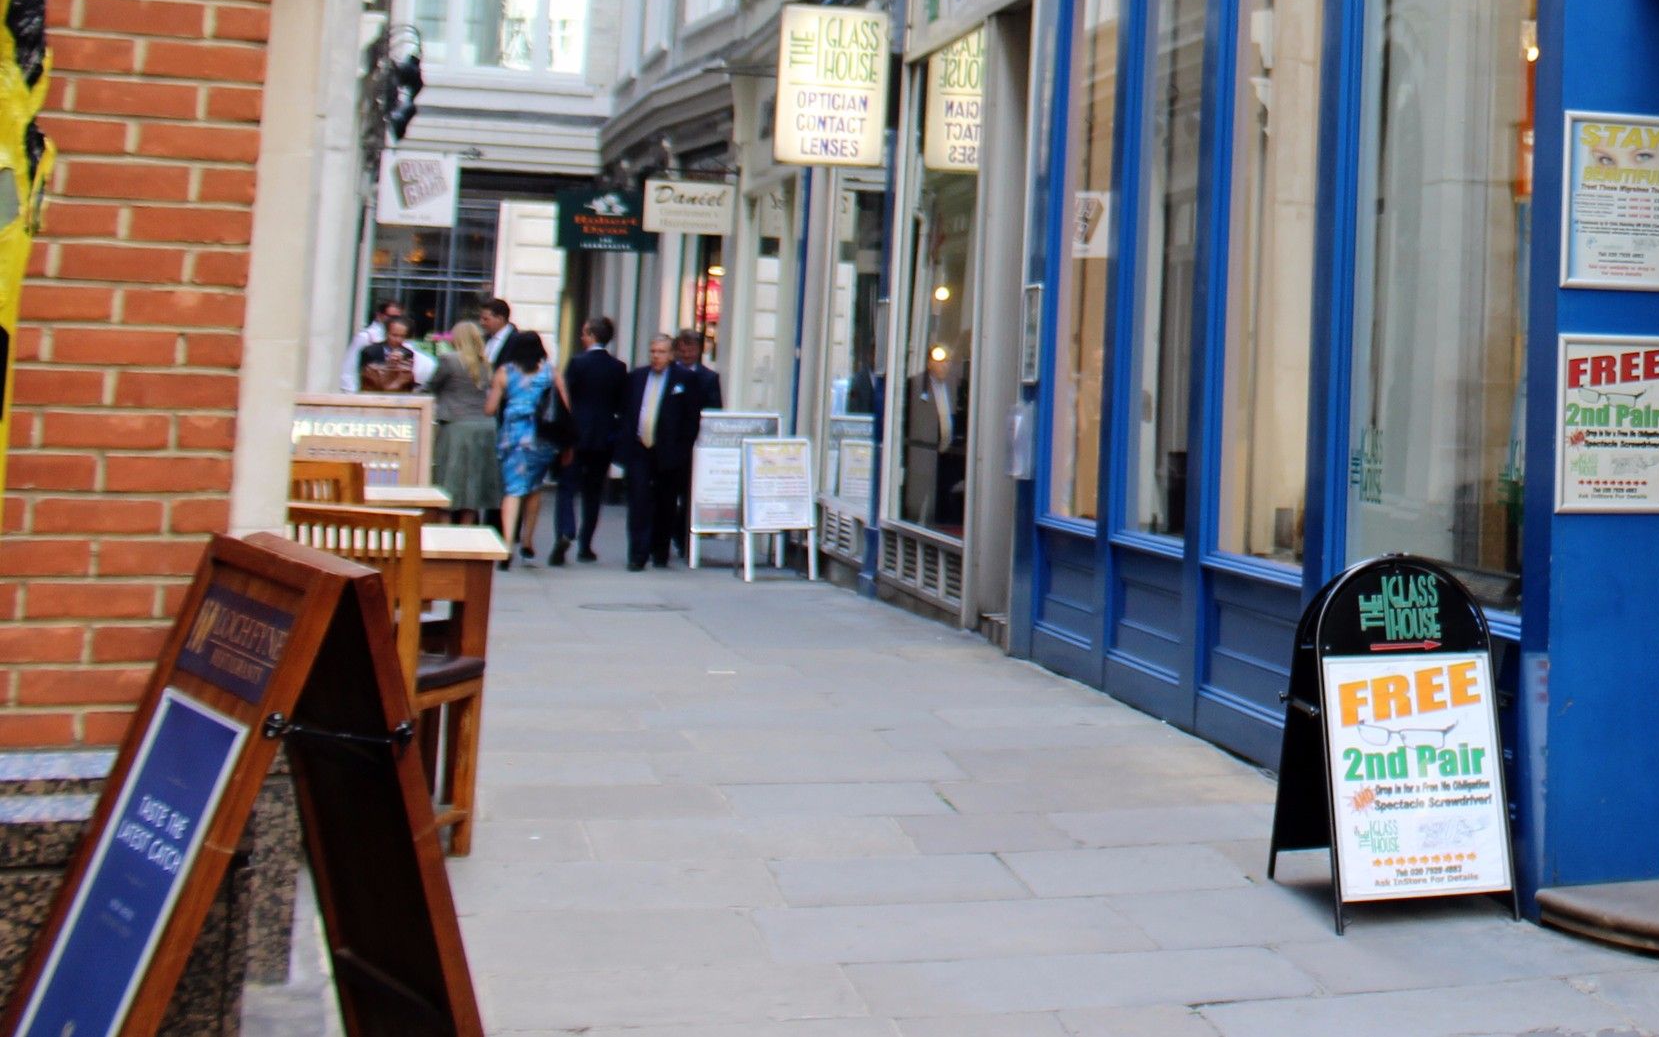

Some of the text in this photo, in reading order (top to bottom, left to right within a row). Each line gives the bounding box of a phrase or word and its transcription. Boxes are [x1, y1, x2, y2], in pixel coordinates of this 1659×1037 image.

[789, 30, 816, 68] THE
[825, 16, 880, 52] GLASS
[823, 50, 880, 84] HOUSE
[796, 90, 869, 114] OPTICIAN
[795, 113, 867, 135] CONTACT
[799, 136, 860, 158] LENSES
[654, 184, 727, 207] Daniel
[1565, 402, 1611, 428] 2nd
[1386, 574, 1437, 609] GLASS
[1359, 594, 1385, 632] THE
[1388, 606, 1442, 641] HOUSE
[1338, 660, 1482, 728] FREE
[1342, 742, 1486, 782] 2nd Pair
[138, 794, 191, 840] TASTE THE
[116, 818, 154, 854] LATEST
